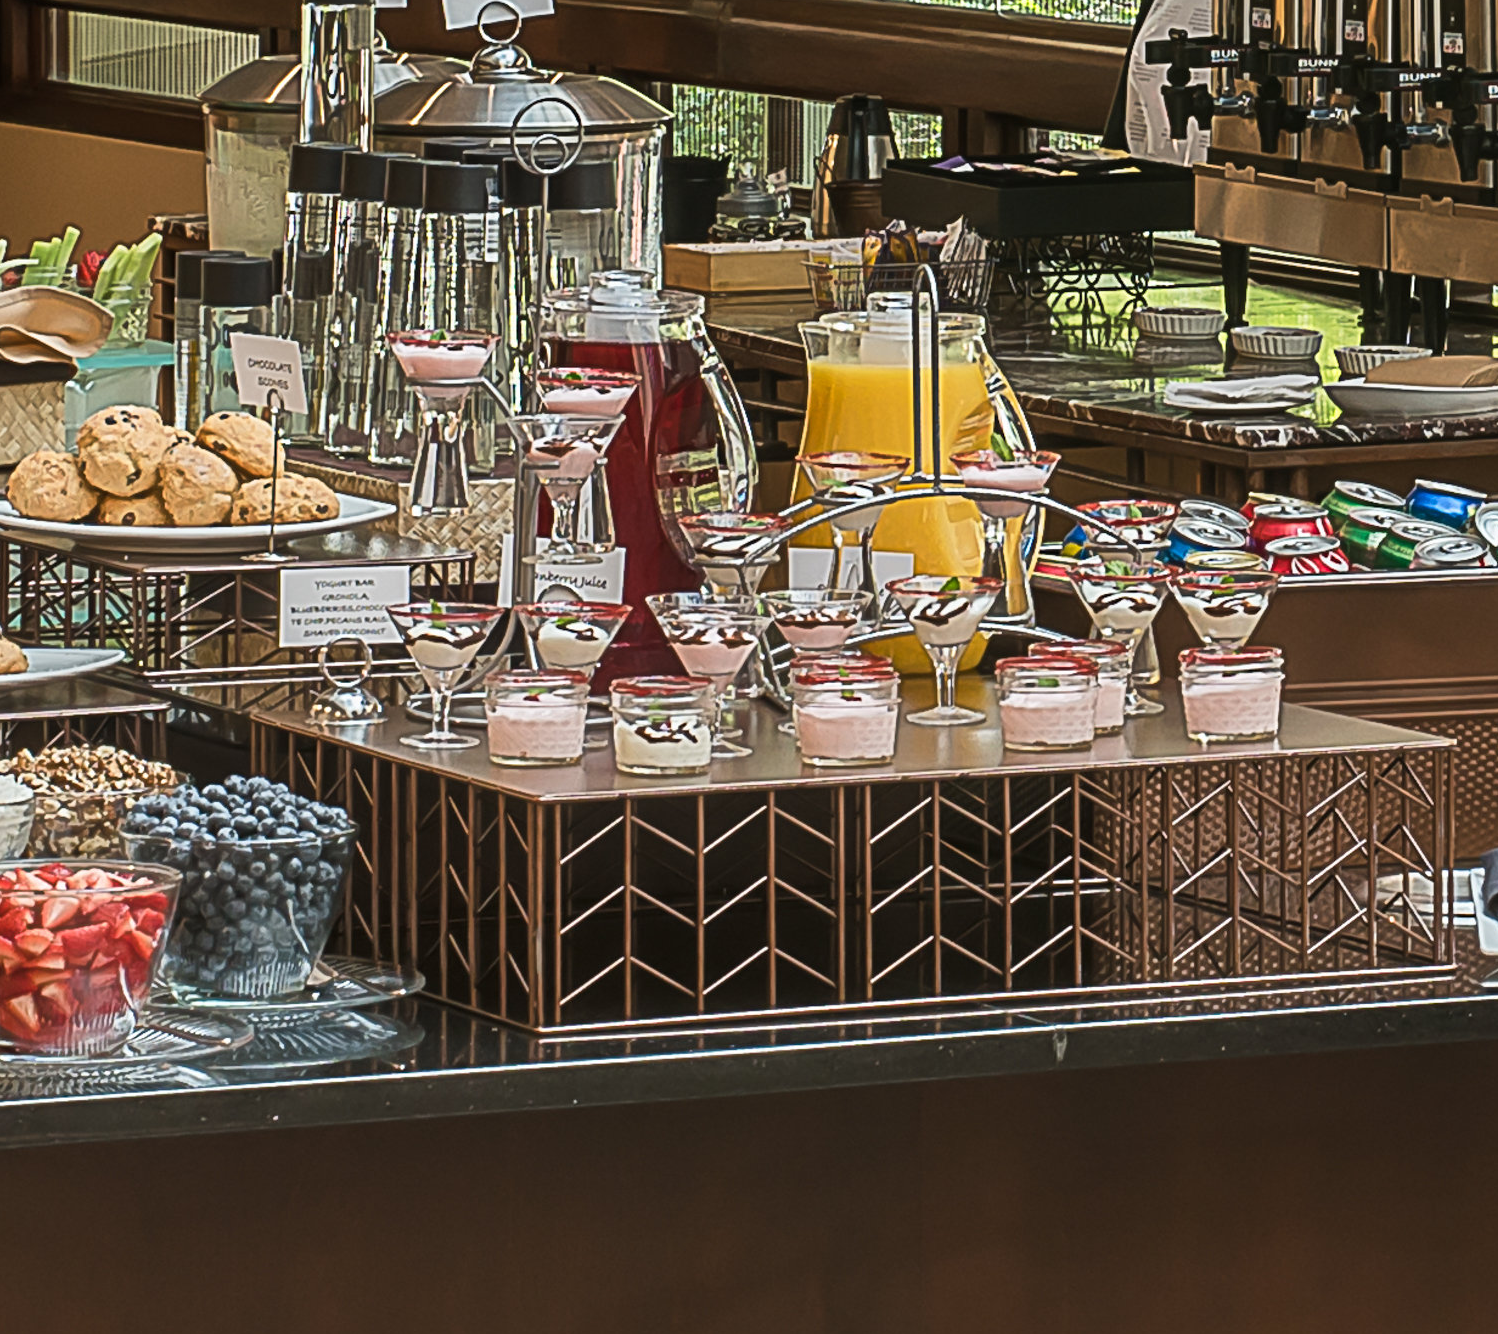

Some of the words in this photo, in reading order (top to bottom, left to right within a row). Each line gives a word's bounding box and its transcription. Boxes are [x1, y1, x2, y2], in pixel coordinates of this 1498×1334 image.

[1210, 48, 1239, 59] BUN
[1298, 58, 1339, 68] BUNN
[247, 357, 292, 374] CHOCOLATE
[257, 376, 289, 390] SCONES
[355, 578, 375, 586] BAR
